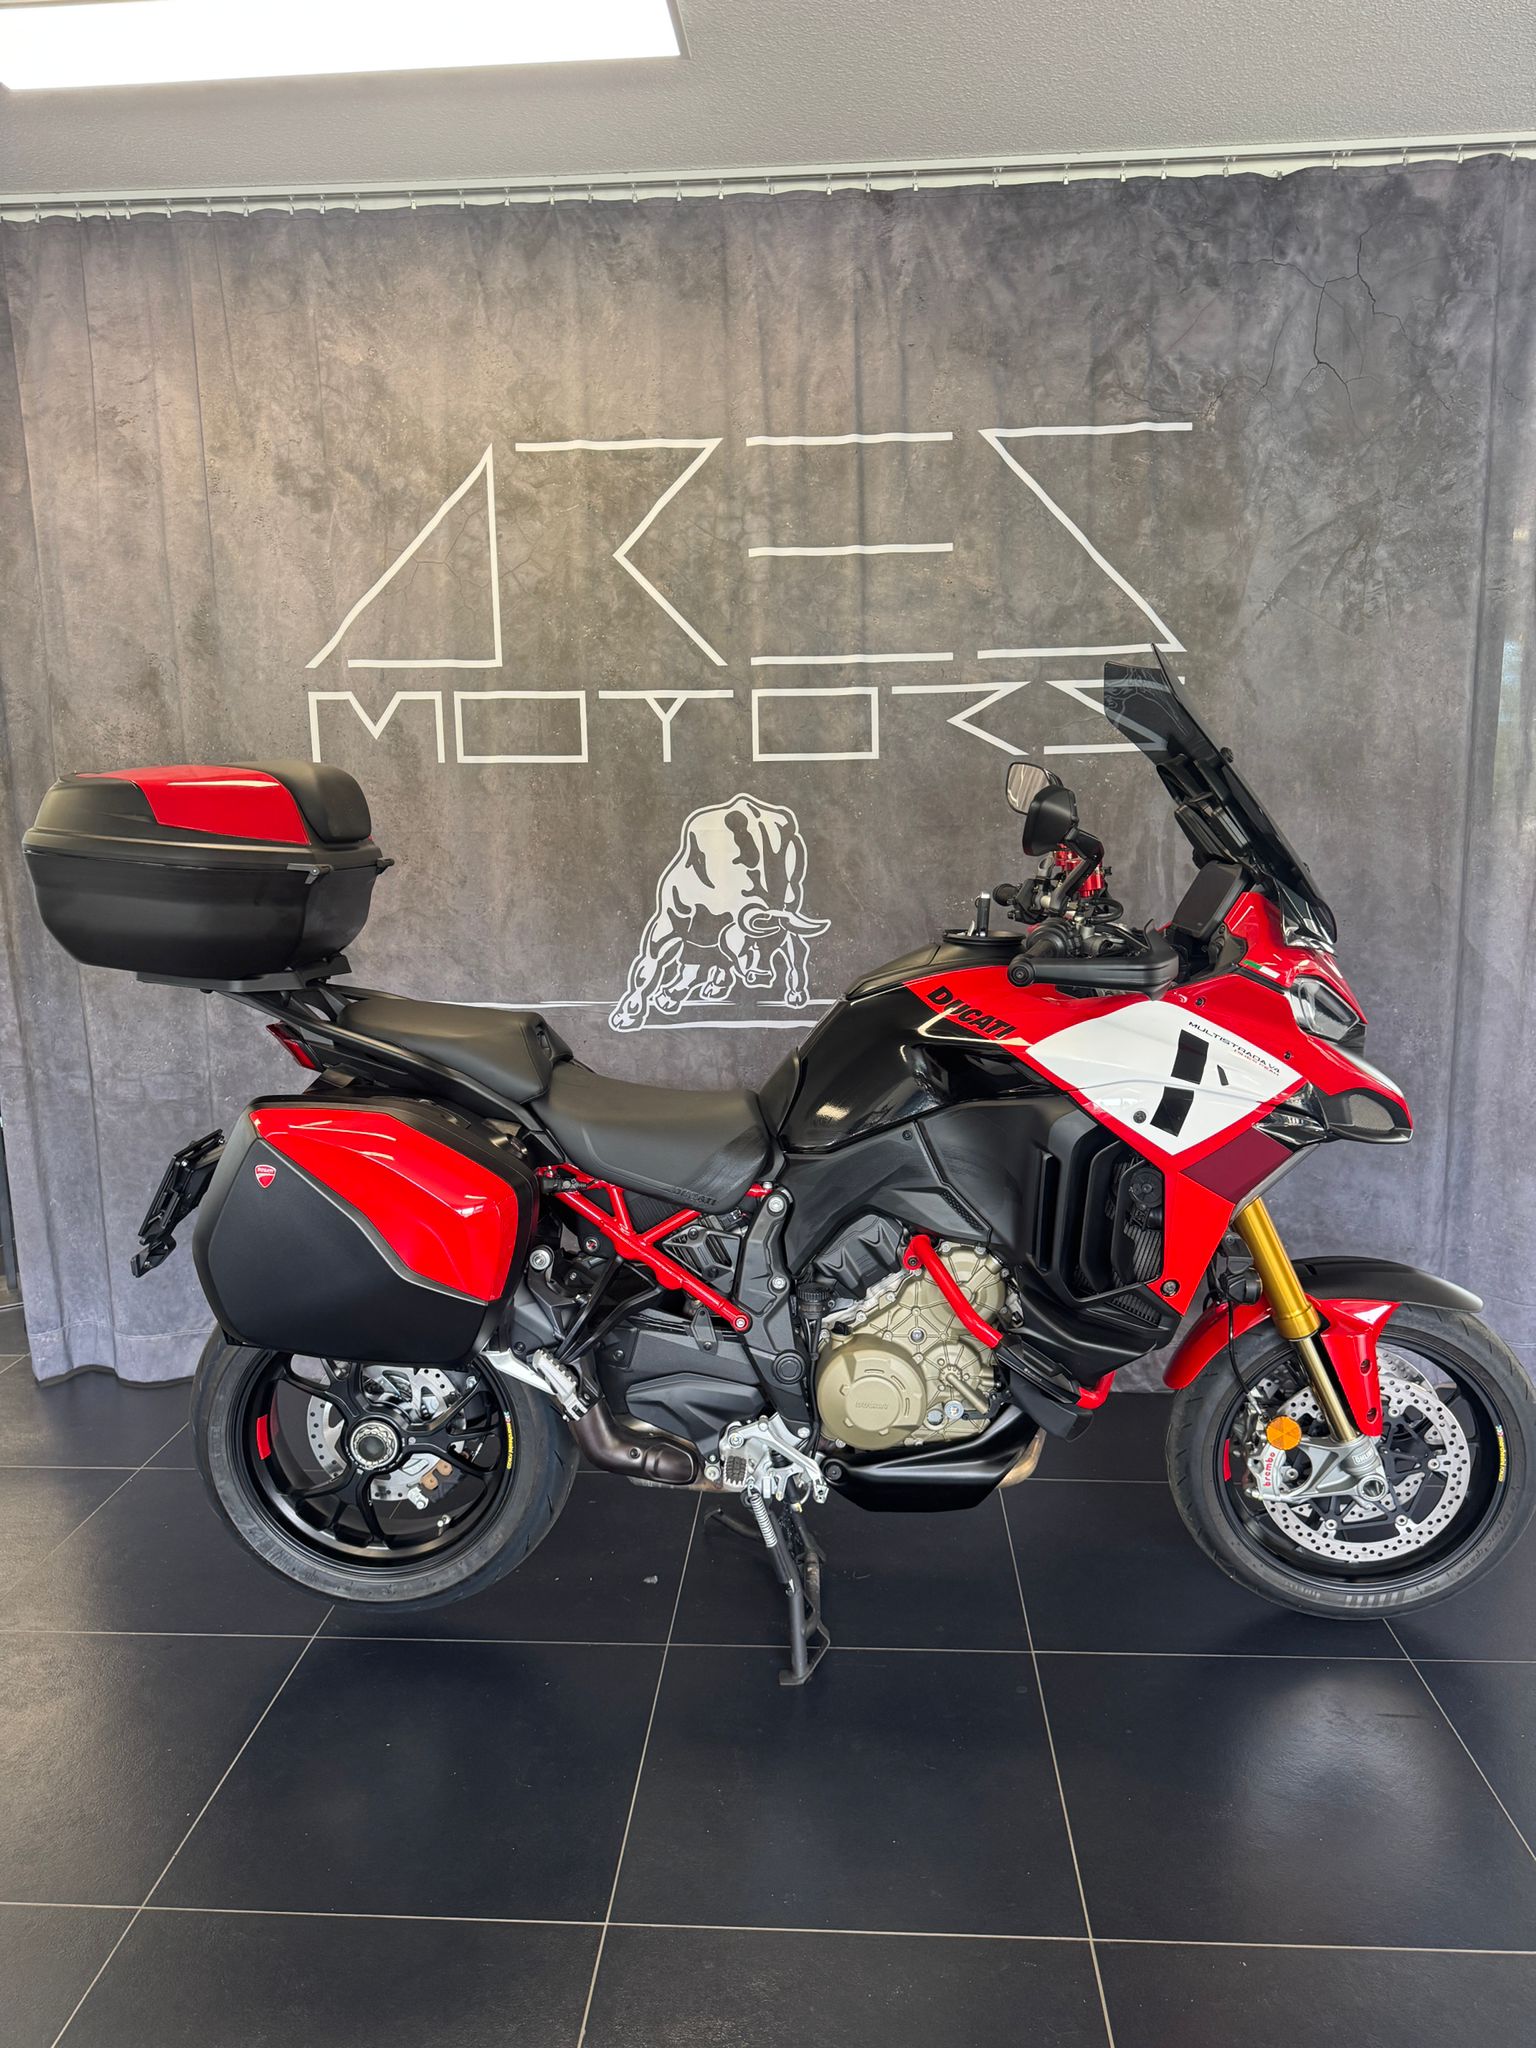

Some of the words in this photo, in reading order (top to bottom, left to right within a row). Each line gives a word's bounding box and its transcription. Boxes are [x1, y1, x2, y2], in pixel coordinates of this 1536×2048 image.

[926, 985, 1018, 1040] DUCATI
[1188, 1021, 1267, 1066] MULTISTRADA
[1263, 1452, 1276, 1487] brembo
